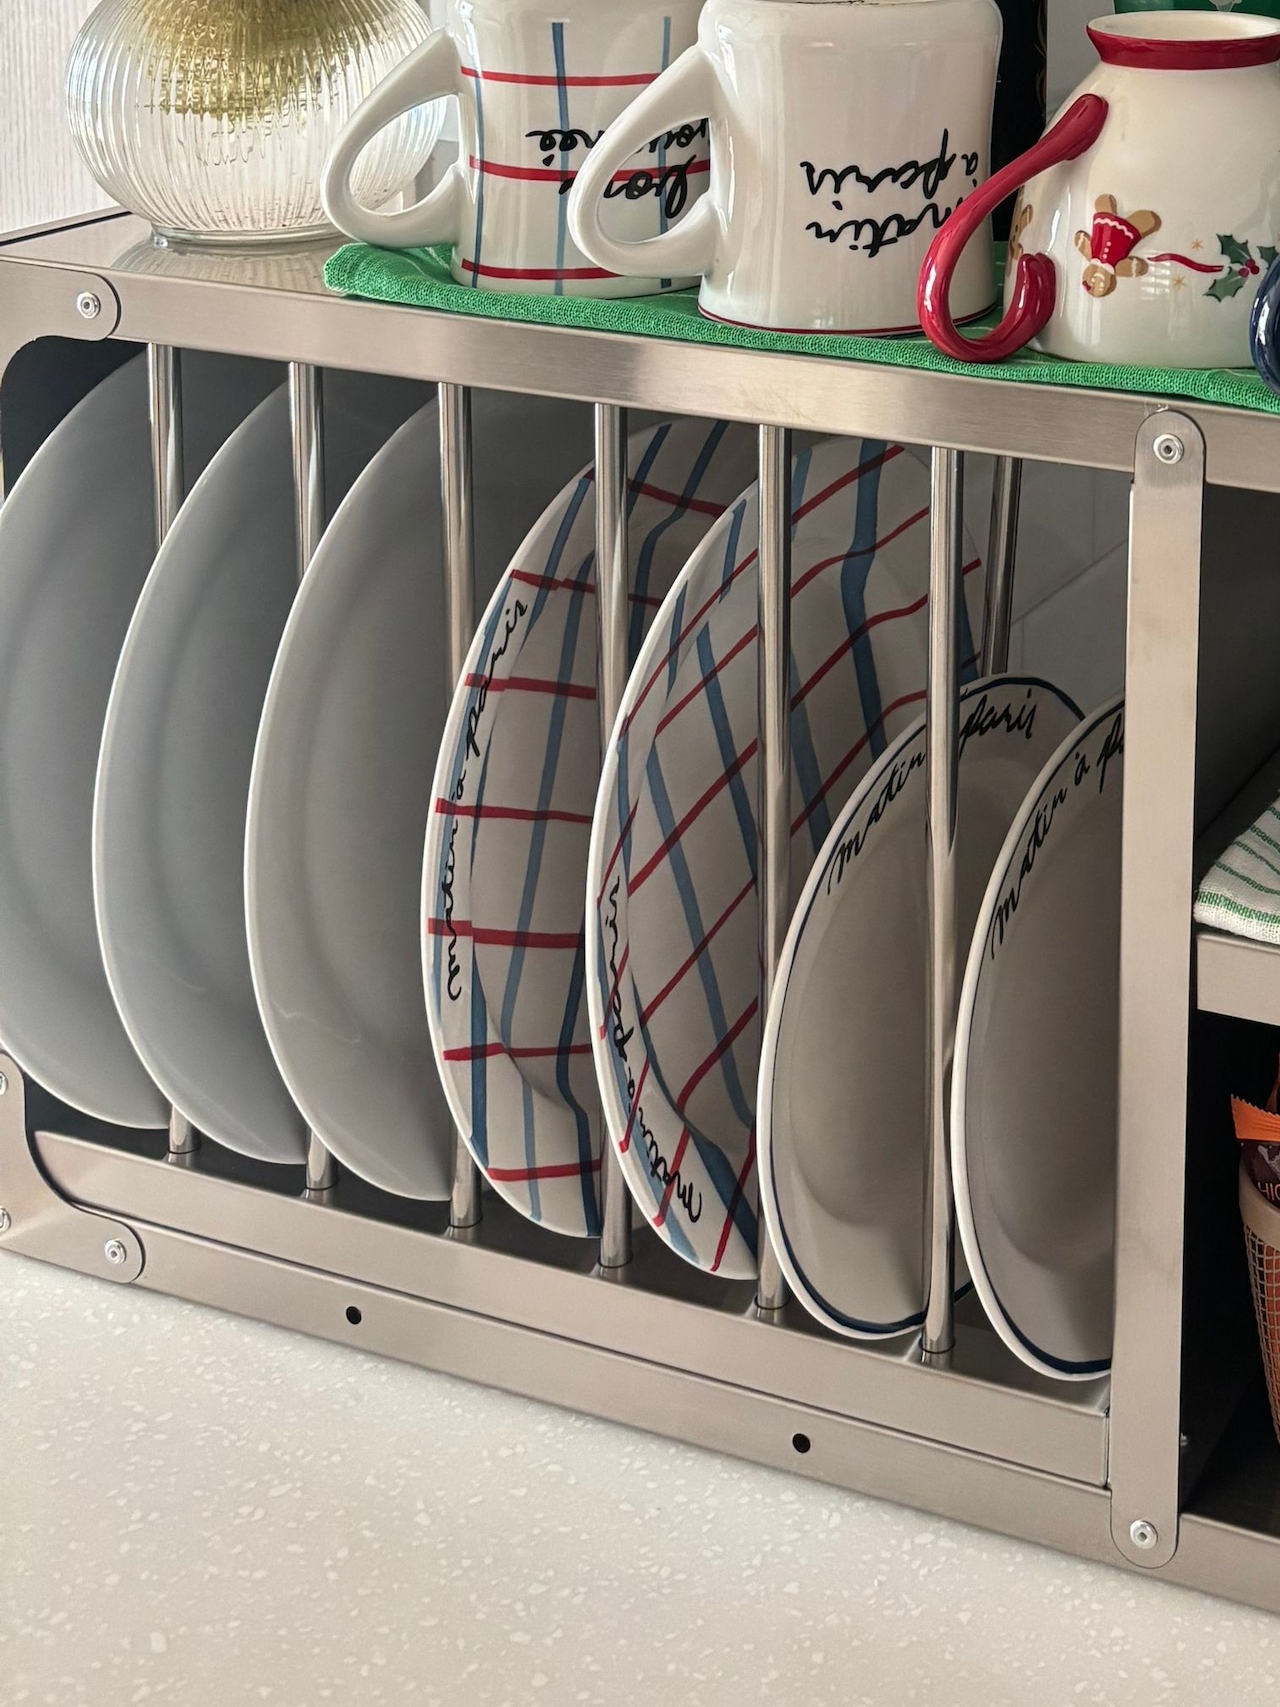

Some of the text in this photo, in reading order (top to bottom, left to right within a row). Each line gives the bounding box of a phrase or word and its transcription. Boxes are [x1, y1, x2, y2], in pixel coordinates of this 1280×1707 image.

[800, 128, 956, 211] paris
[441, 819, 462, 1002] matin
[464, 599, 528, 760] paris
[827, 750, 926, 895] matin
[990, 786, 1067, 960] matin
[605, 876, 637, 1060] paris
[638, 1105, 703, 1224] matin
